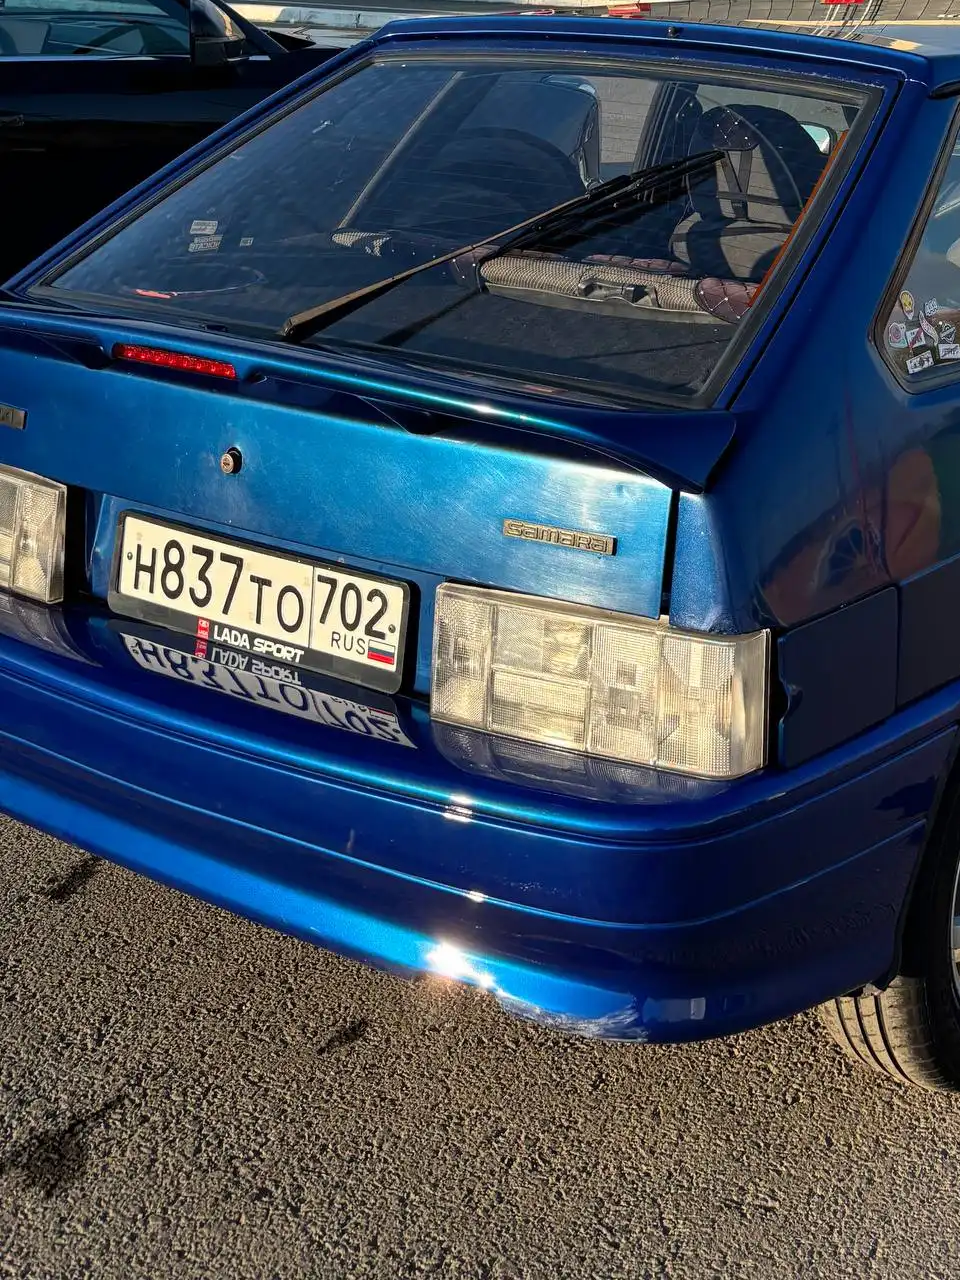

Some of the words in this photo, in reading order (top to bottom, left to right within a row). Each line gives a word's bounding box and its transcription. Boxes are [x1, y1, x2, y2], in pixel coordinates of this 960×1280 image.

[317, 575, 389, 640] 702
[213, 625, 250, 650] LADA
[252, 637, 305, 663] SPORT
[331, 632, 366, 655] RUS
